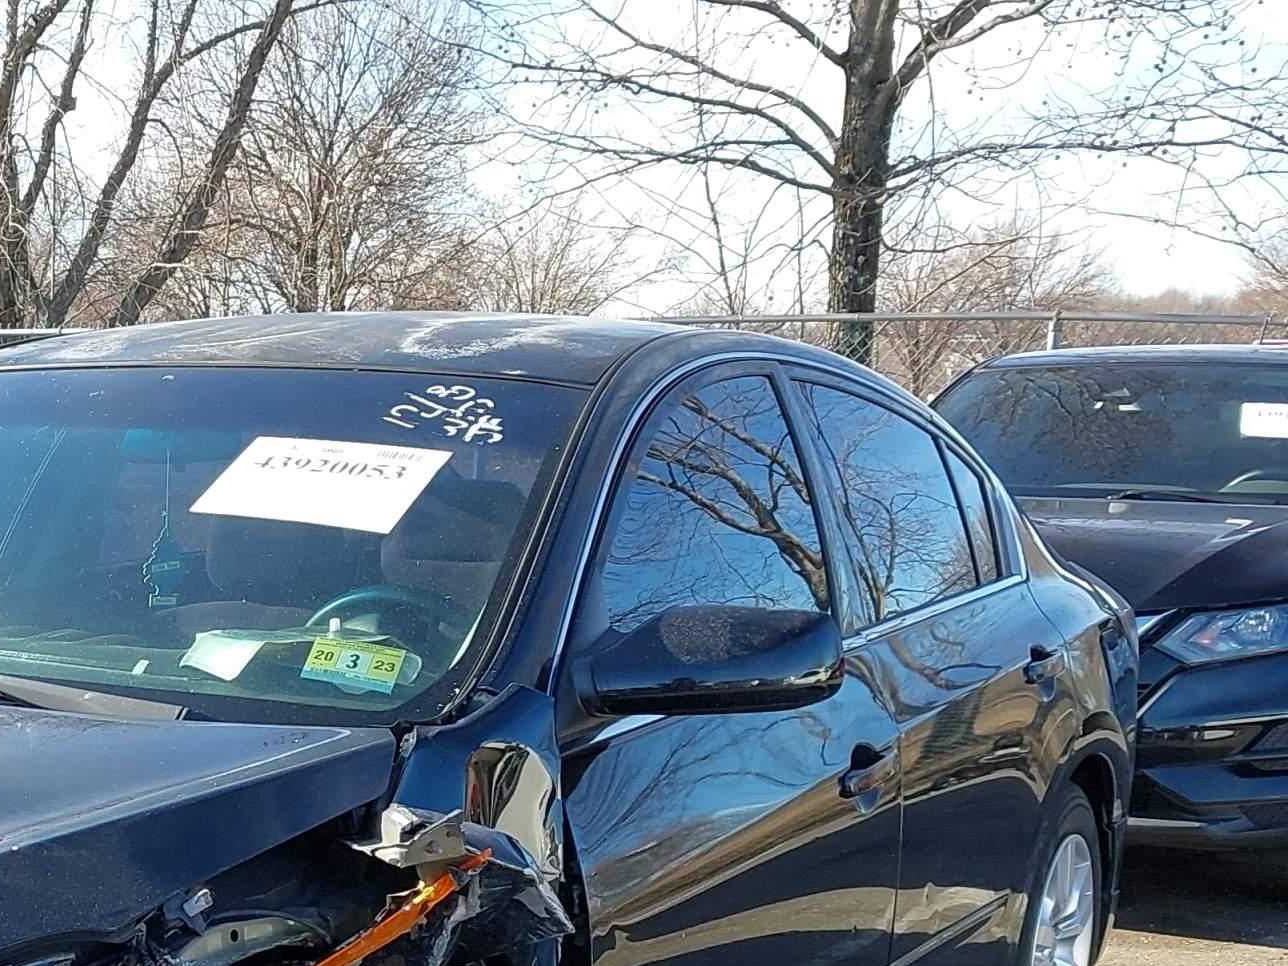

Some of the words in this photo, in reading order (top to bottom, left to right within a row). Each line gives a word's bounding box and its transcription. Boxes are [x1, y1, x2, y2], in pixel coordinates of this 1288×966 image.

[254, 455, 407, 479] 43920053
[313, 649, 335, 662] 20
[345, 653, 361, 669] 3
[372, 660, 396, 672] 23
